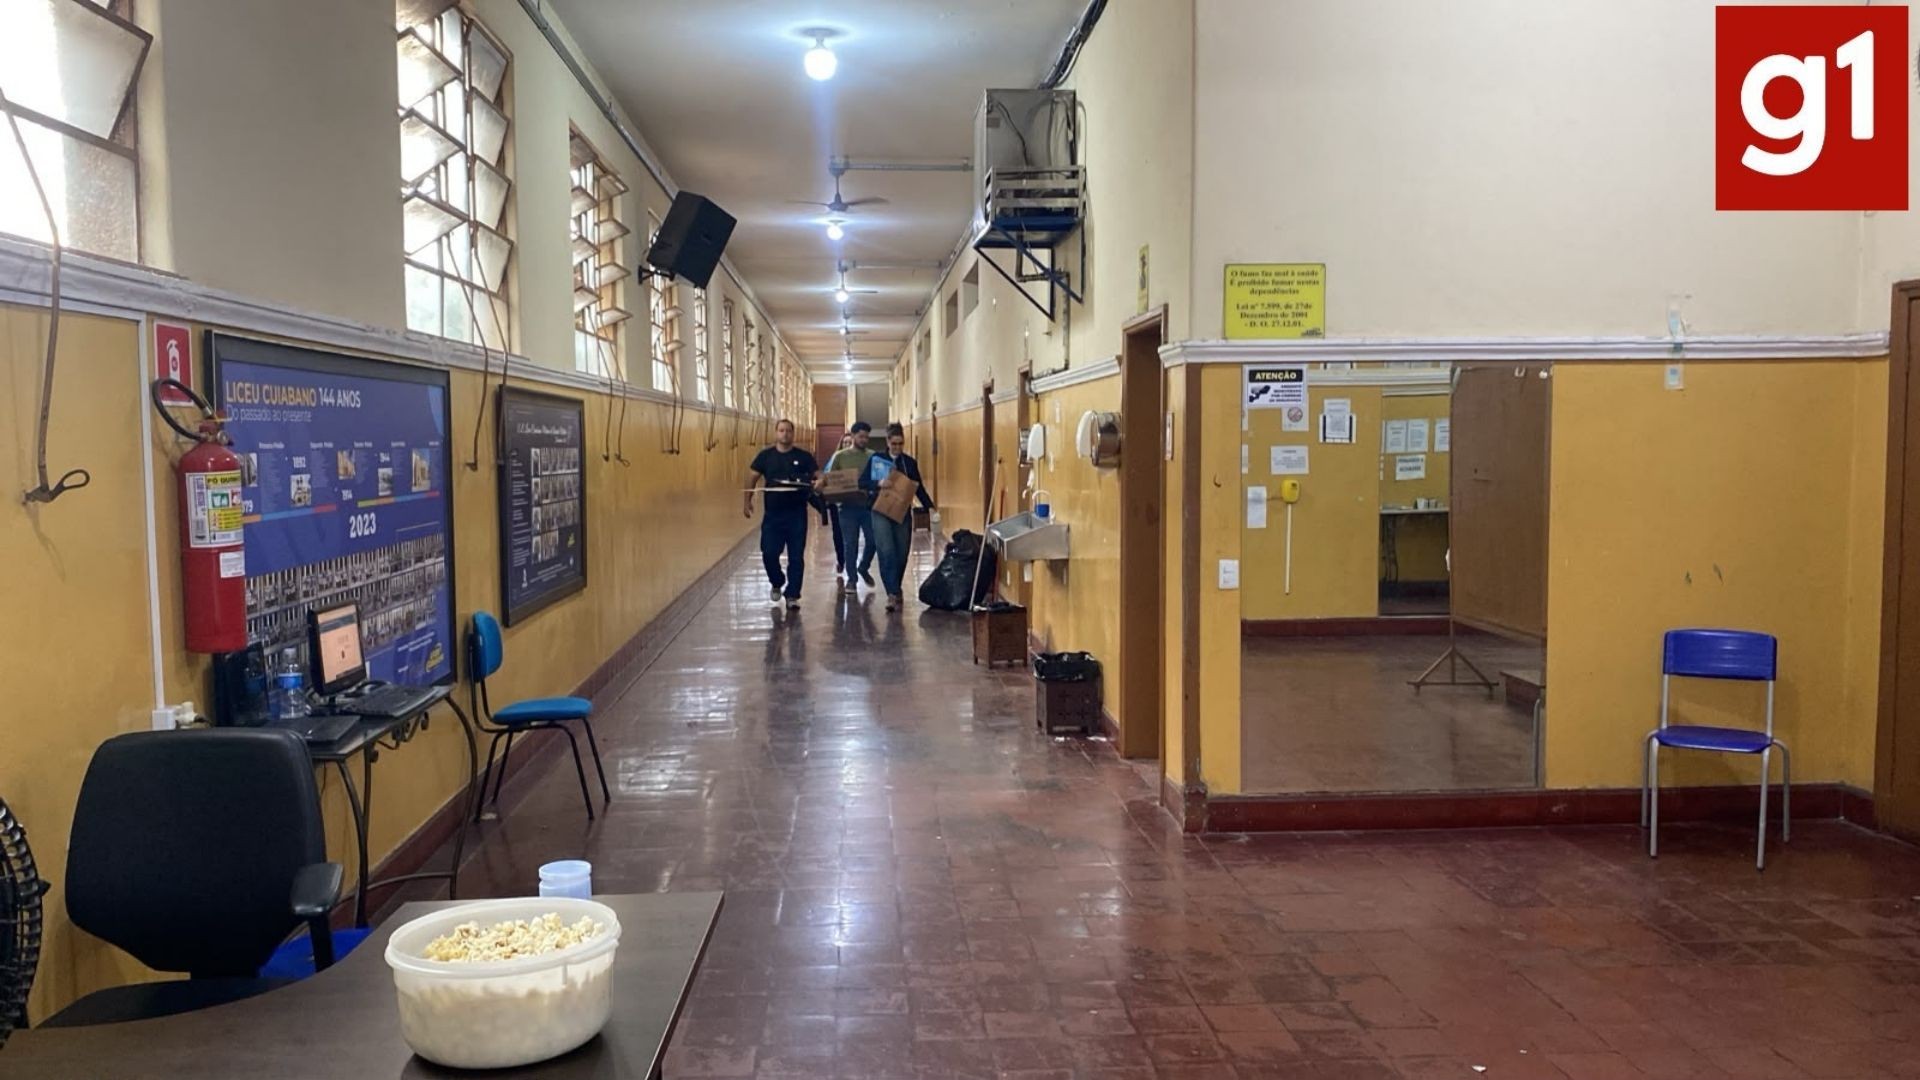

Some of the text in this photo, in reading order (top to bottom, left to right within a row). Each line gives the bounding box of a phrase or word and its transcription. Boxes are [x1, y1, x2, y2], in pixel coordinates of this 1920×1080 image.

[1237, 279, 1270, 287] proibido
[1240, 311, 1278, 319] Dezembro
[1255, 370, 1297, 381] ATENÇÃO
[225, 381, 361, 408] LICEU CUIABANO 144 ANOS
[240, 406, 271, 423] passado
[272, 409, 282, 421] ao
[282, 409, 313, 423] presente
[349, 512, 377, 539] 2023
